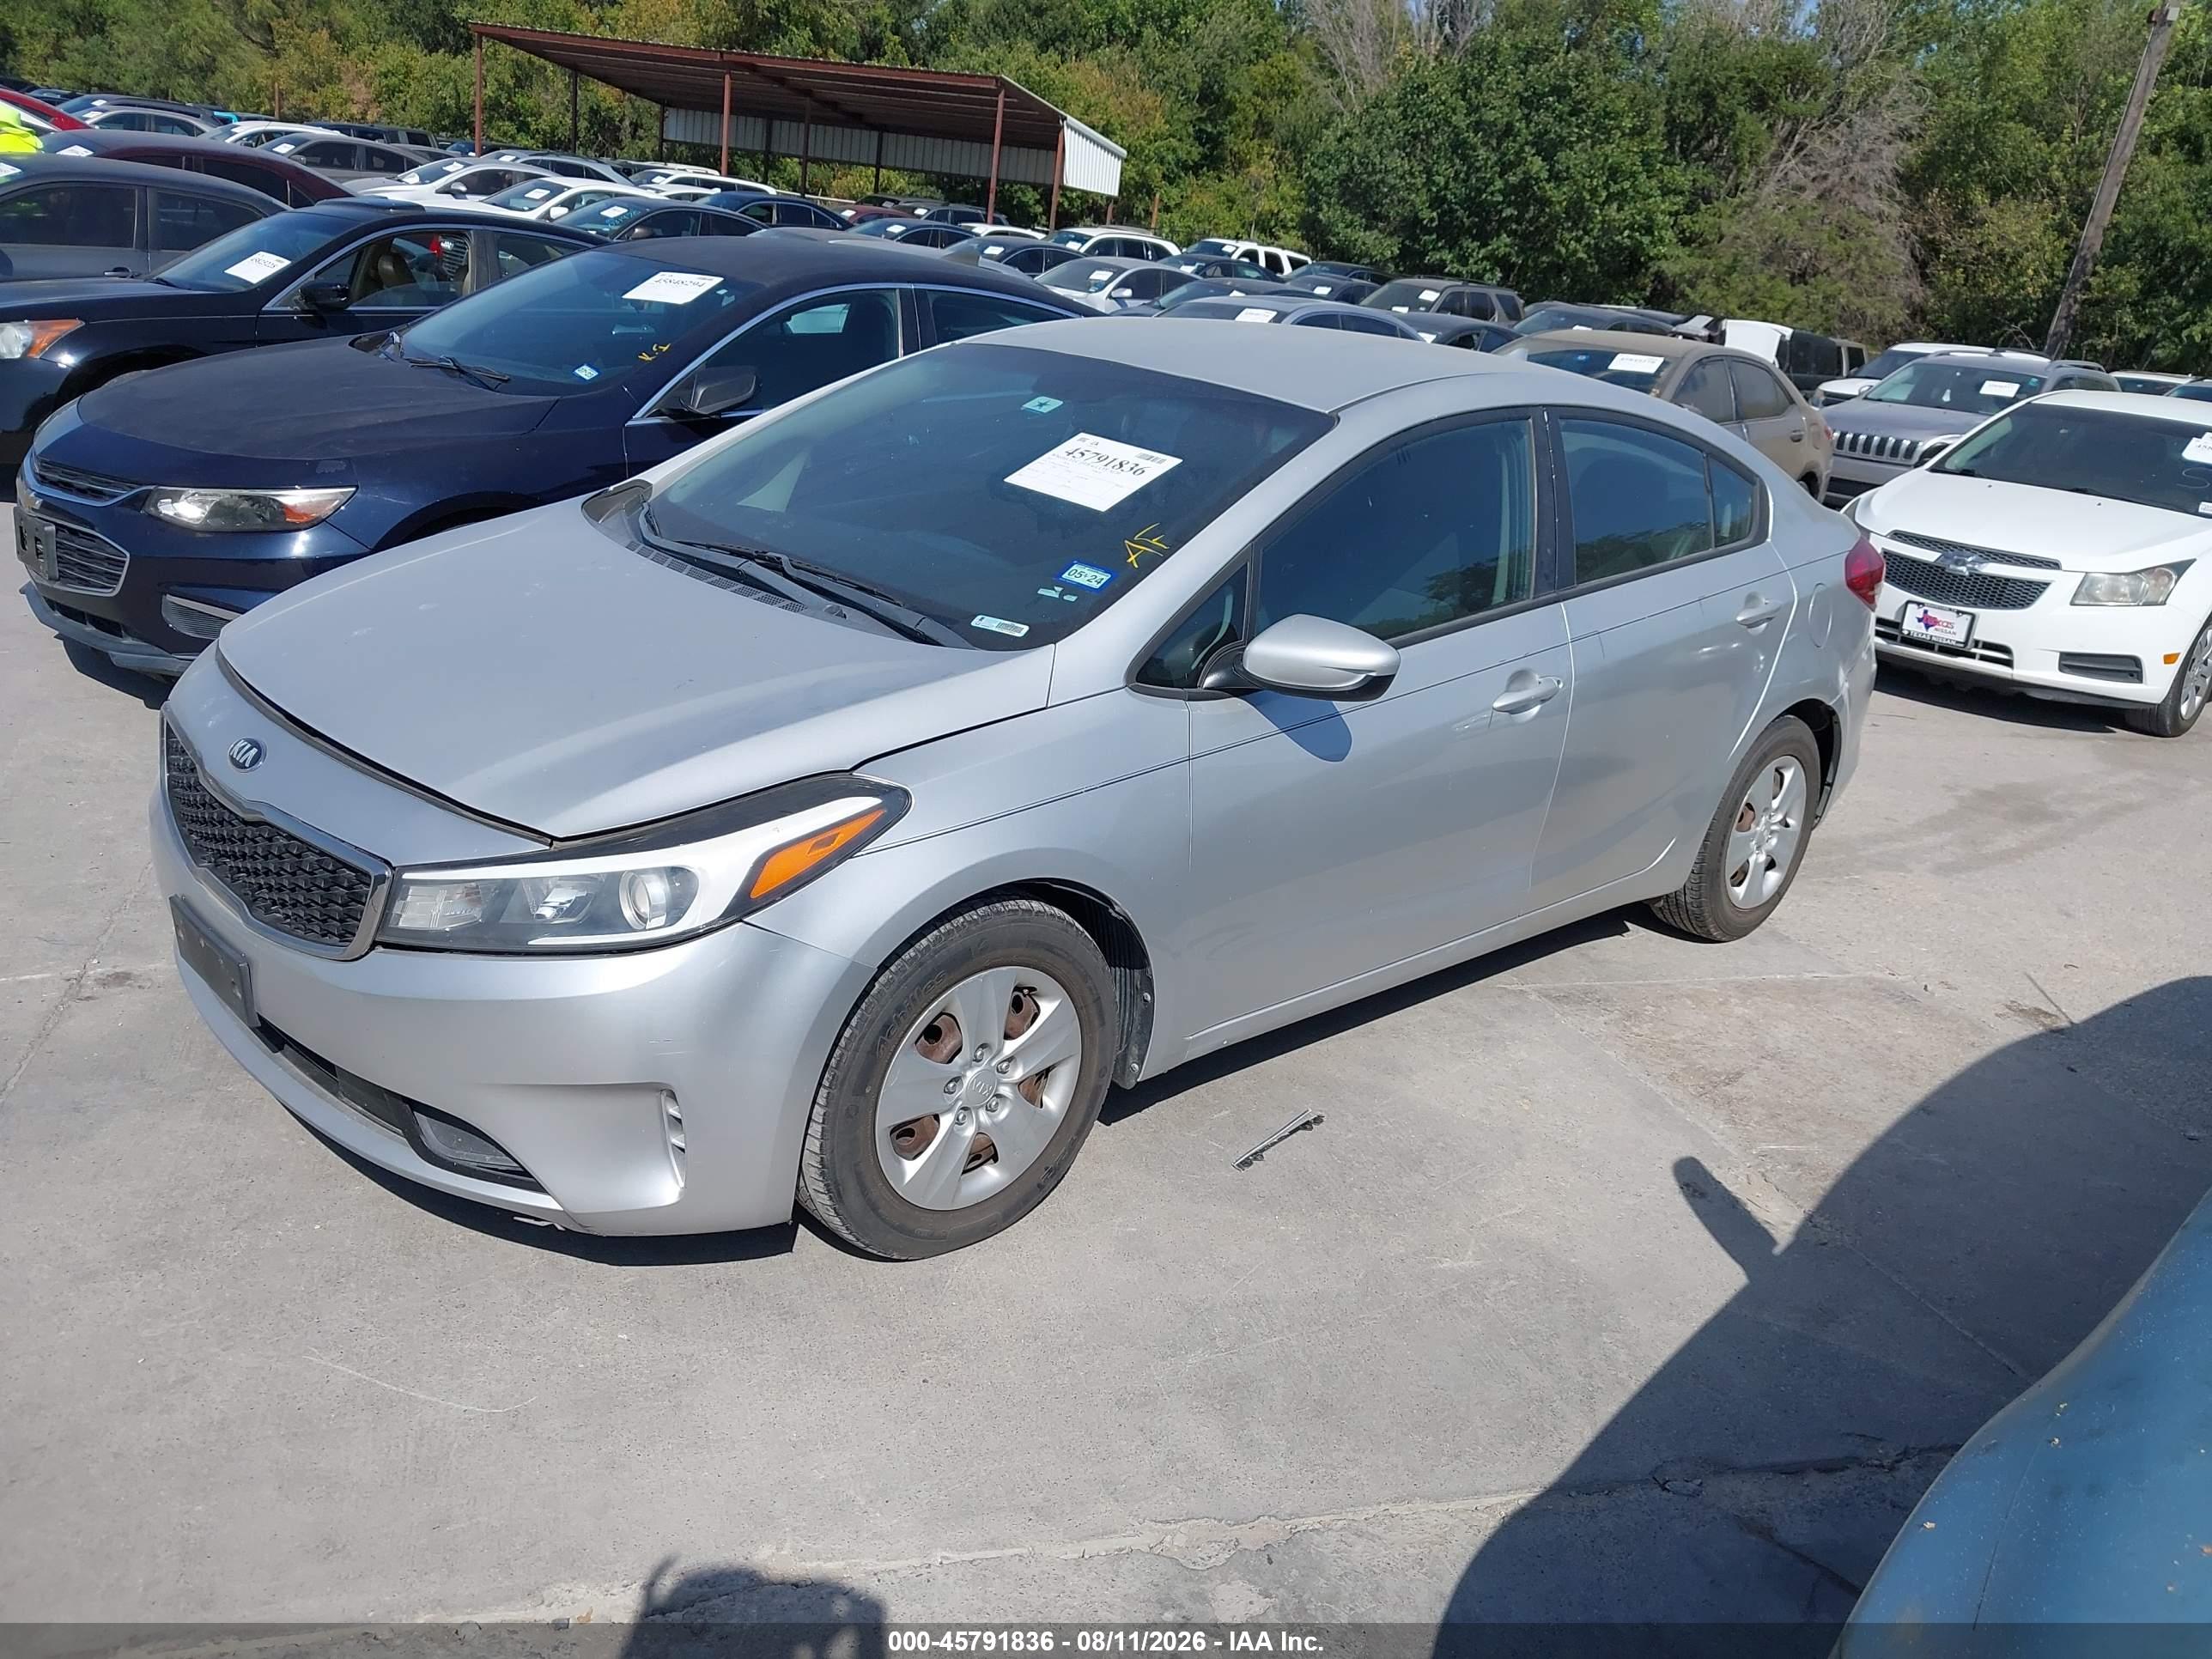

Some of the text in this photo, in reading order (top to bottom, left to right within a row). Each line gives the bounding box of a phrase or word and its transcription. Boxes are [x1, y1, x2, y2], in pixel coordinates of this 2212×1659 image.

[1064, 446, 1152, 476] 45791836
[1910, 630, 1957, 645] TEXAS NISSAN
